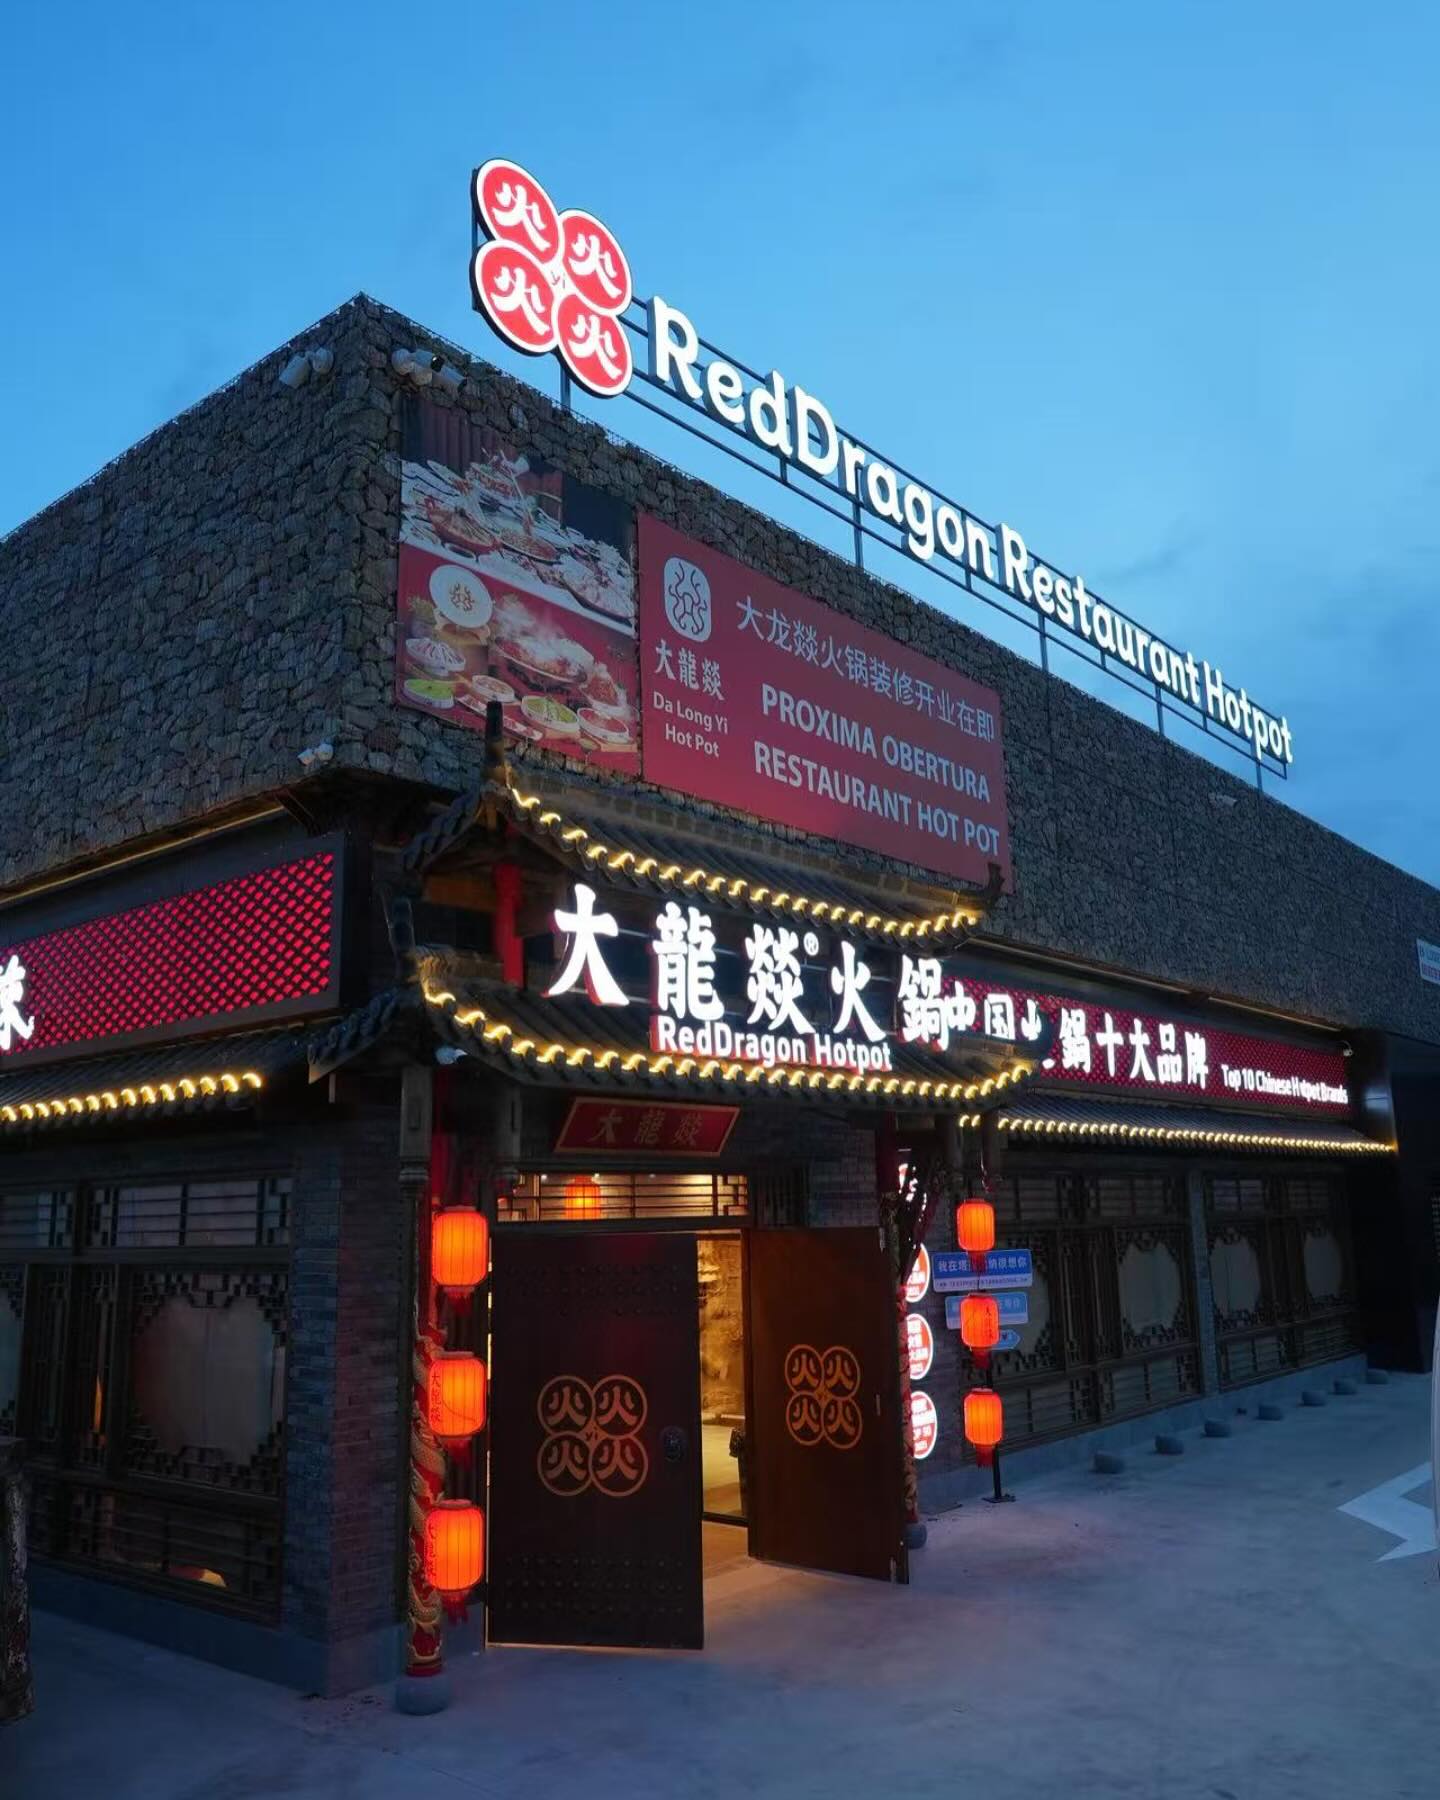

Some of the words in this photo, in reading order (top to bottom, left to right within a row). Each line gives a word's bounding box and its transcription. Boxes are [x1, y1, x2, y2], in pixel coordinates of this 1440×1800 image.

[654, 296, 994, 561] RedDragon
[1001, 523, 1200, 702] Restaurant
[1204, 661, 1293, 763] Hotpot
[654, 639, 725, 701] 大龍燚
[736, 595, 994, 743] 大龙燚火锅装修开业在即
[654, 692, 673, 714] Da
[676, 701, 712, 731] Long
[715, 709, 728, 734] Yi
[665, 724, 692, 749] Hot
[695, 733, 719, 758] Pot
[762, 683, 877, 759] PROXIMA
[883, 737, 991, 803] OBERTURA
[754, 740, 911, 825] RESTAURANT
[918, 801, 958, 841] HOT
[964, 818, 1000, 857] POT
[658, 1015, 807, 1068] RedDragon
[815, 1033, 892, 1075] Hotpot
[1221, 1064, 1241, 1092] Top
[1242, 1068, 1254, 1091] 10
[1256, 1070, 1292, 1095] Chinese
[1292, 1076, 1320, 1102] Hotpot
[1320, 1082, 1348, 1104] Brands
